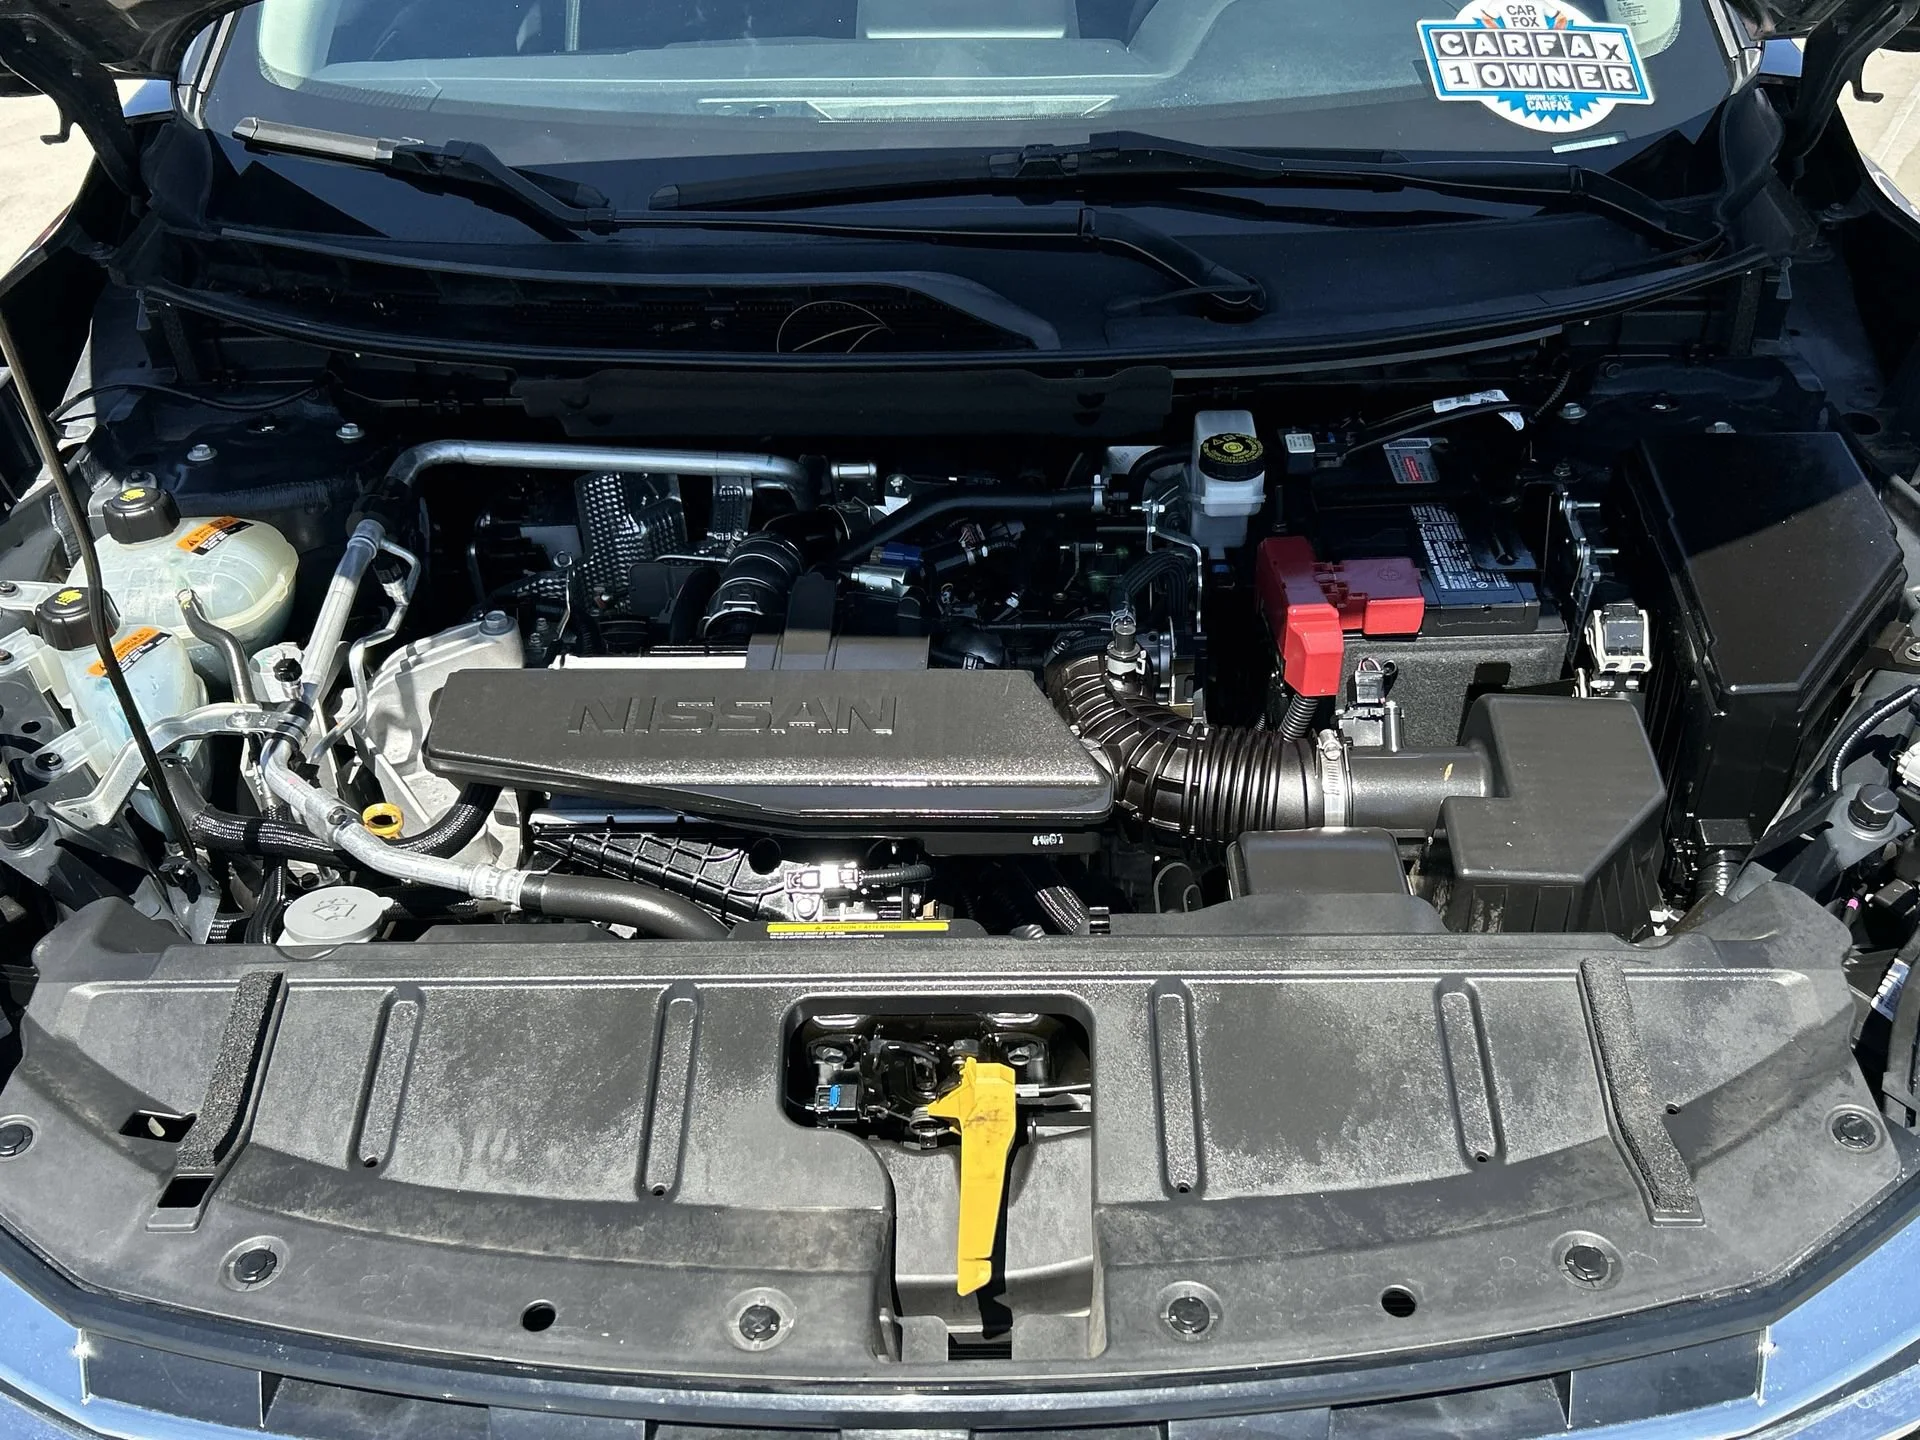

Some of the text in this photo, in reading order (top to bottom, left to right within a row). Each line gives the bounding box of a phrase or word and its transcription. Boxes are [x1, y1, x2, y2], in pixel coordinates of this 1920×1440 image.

[1506, 4, 1537, 16] CAR
[1511, 16, 1540, 27] FOX
[1439, 34, 1623, 61] CARFAX
[1449, 64, 1633, 89] 1 OWNER
[1526, 100, 1574, 111] CARFAX
[567, 697, 898, 735] NISSAN
